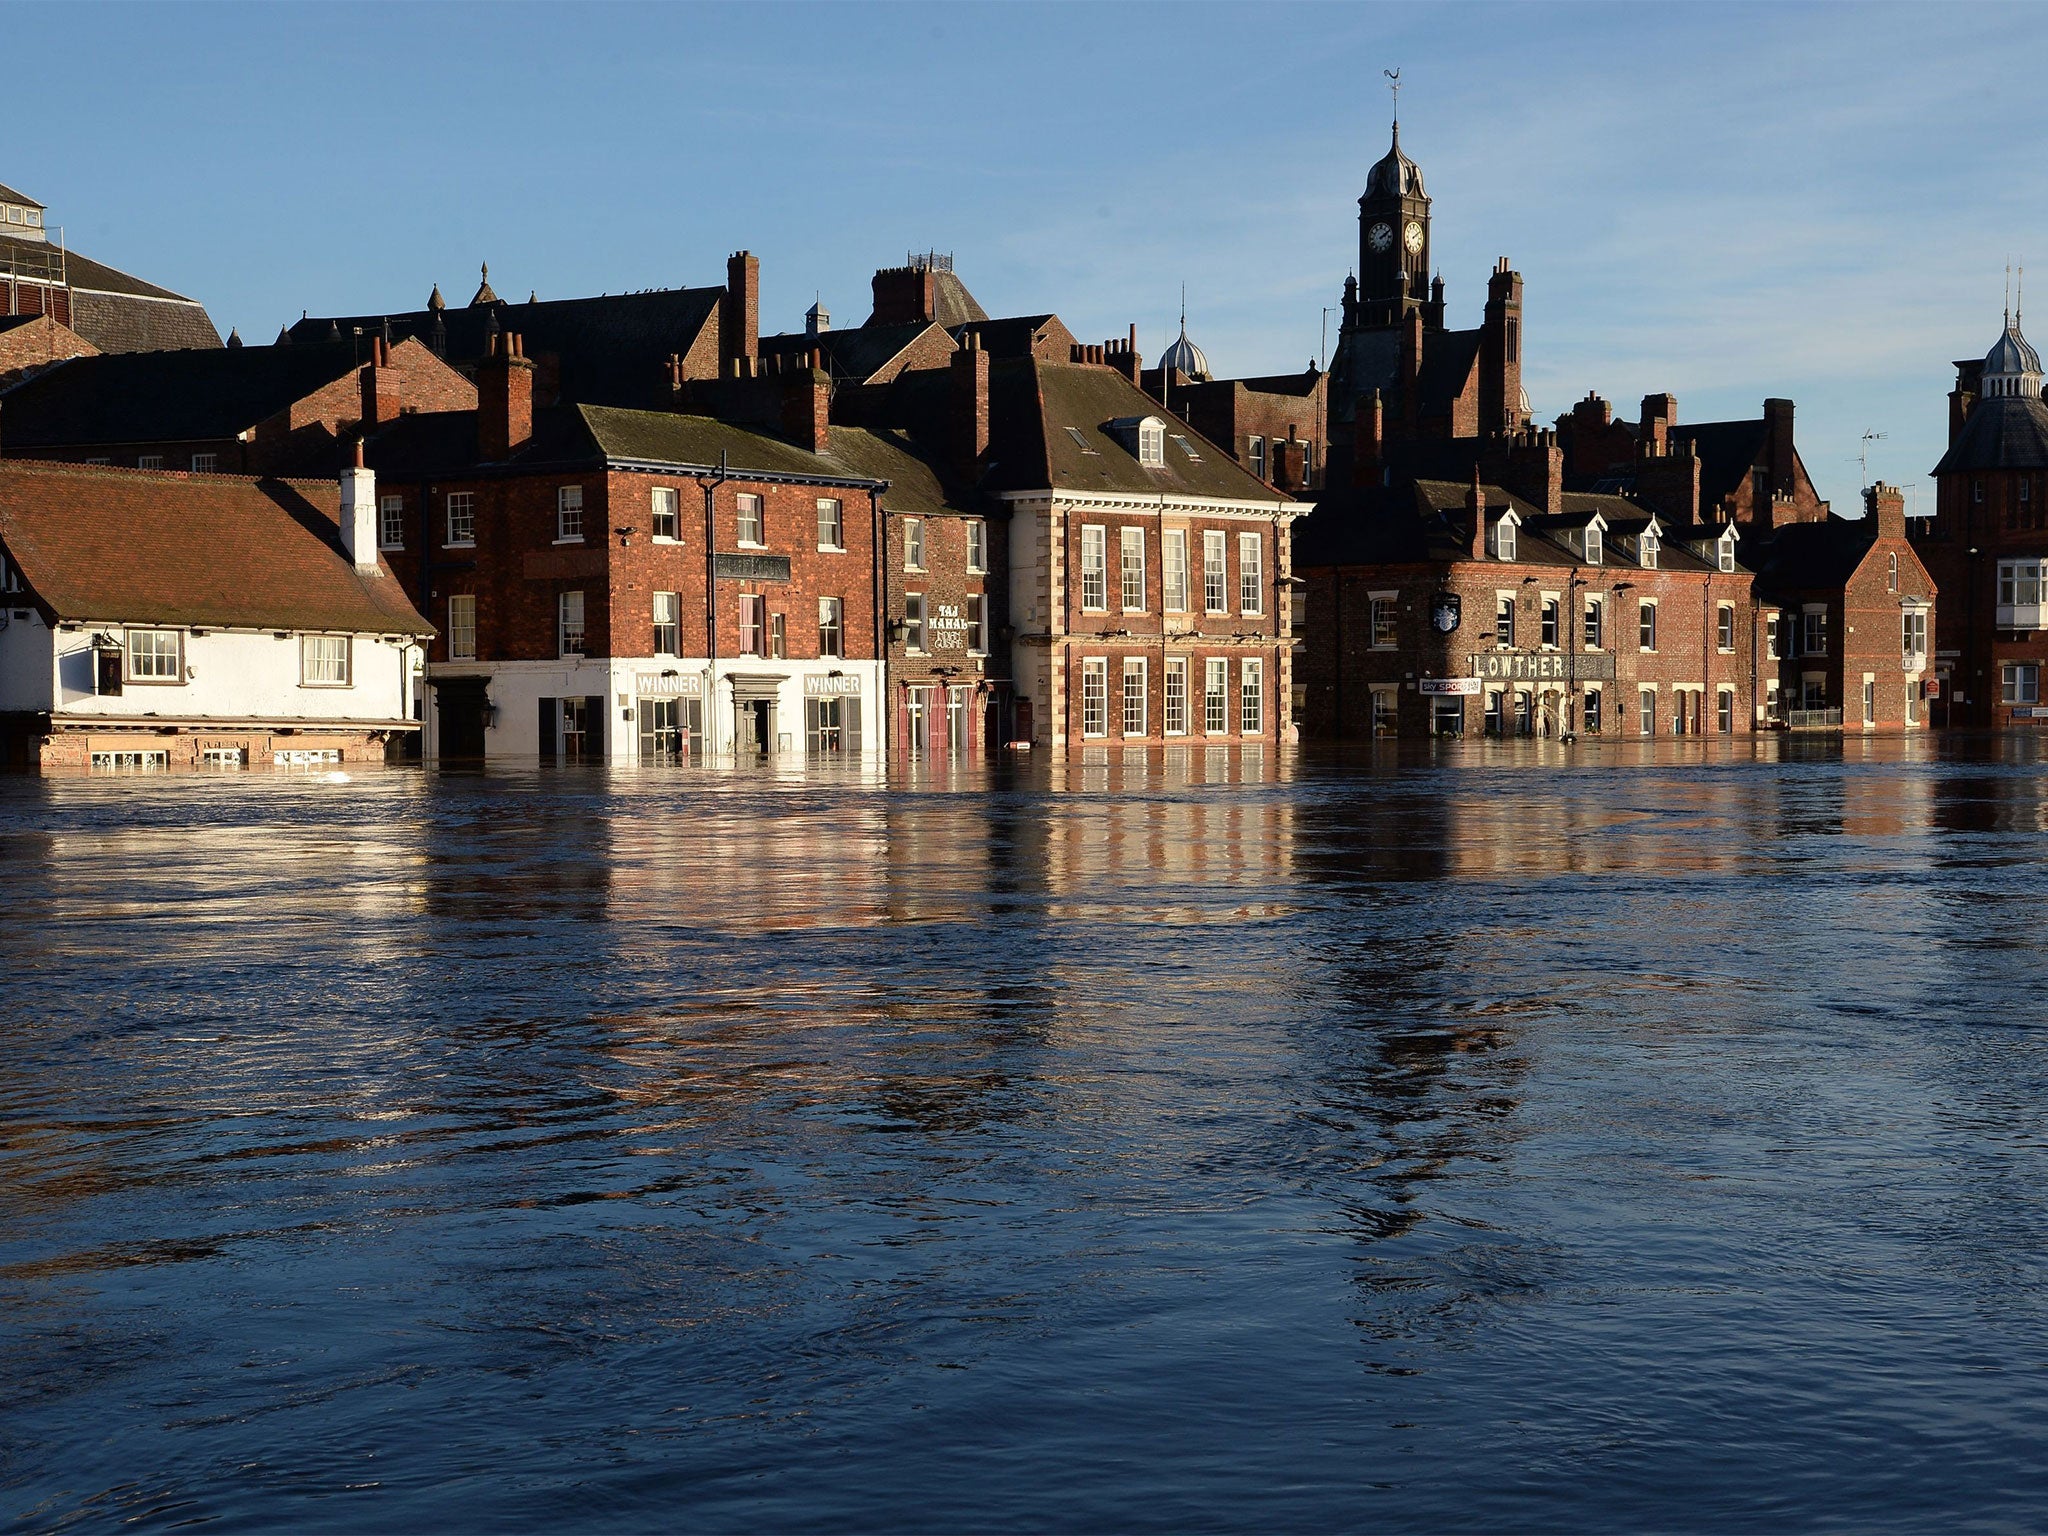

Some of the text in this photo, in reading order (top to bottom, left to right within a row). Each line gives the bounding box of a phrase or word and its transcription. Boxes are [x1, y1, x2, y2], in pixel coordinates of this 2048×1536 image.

[938, 605, 959, 617] TAJ
[928, 617, 968, 630] MAHAL
[1474, 655, 1563, 678] LOWTHER
[637, 675, 699, 693] WINNER
[806, 676, 860, 693] WINNER
[1423, 683, 1436, 692] sky
